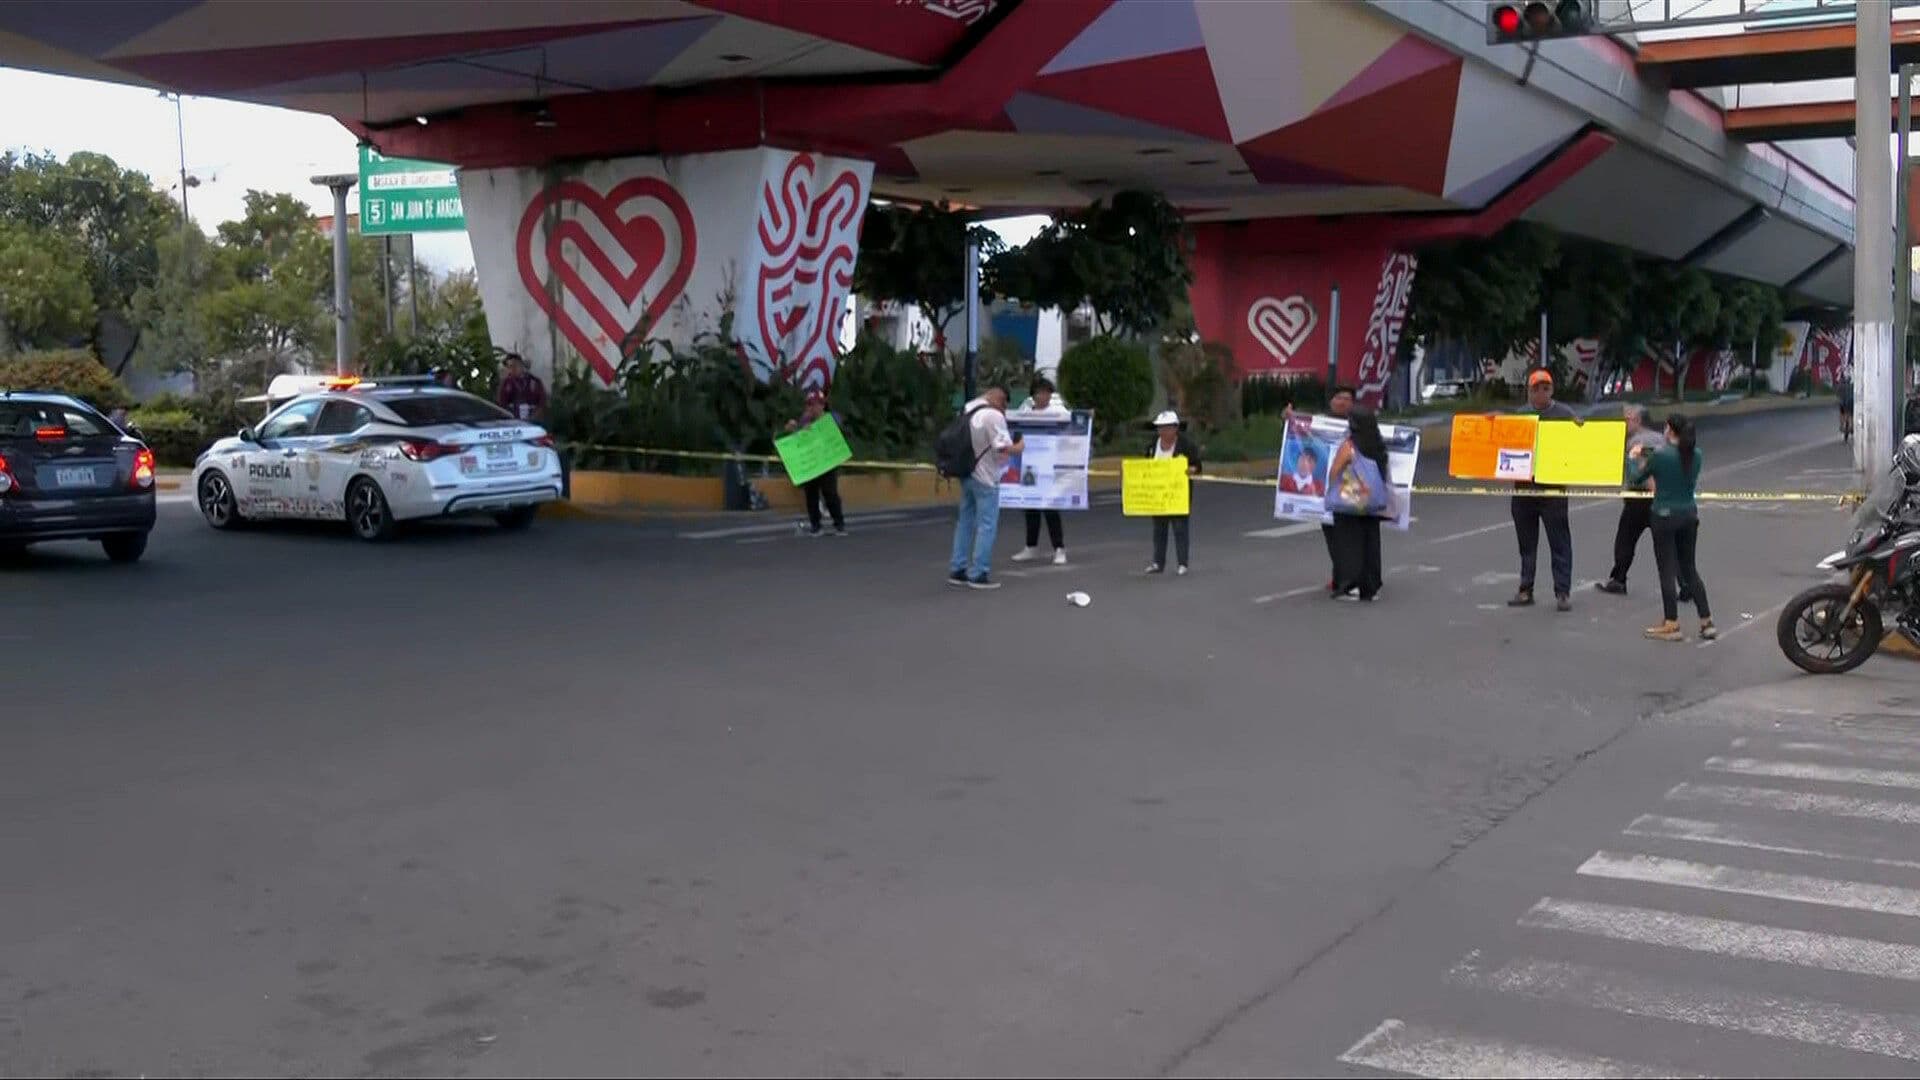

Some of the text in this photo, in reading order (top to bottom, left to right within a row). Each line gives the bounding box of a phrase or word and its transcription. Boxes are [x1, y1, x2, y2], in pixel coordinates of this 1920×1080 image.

[371, 204, 381, 220] 5
[391, 201, 404, 220] SAN
[406, 200, 423, 219] JUAN
[425, 198, 434, 219] DE
[249, 461, 291, 480] POLICÍA
